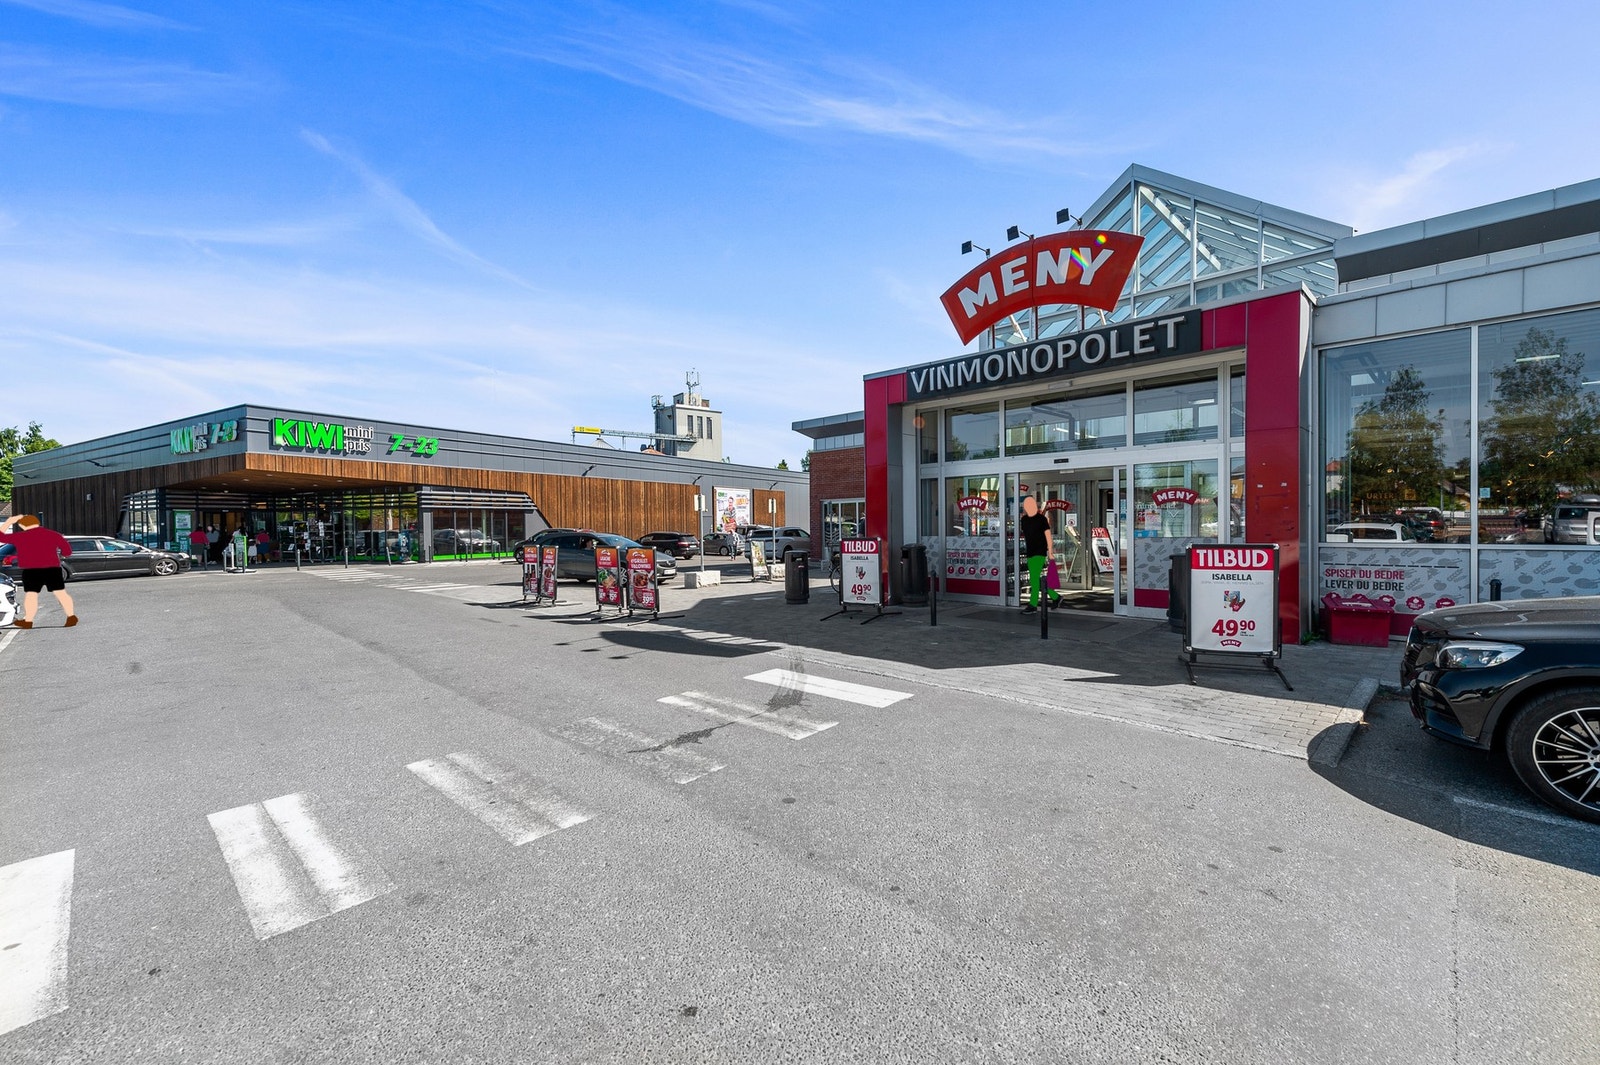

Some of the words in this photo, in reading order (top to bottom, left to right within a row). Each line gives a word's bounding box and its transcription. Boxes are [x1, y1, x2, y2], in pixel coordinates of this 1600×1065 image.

[957, 247, 1114, 319] MENY
[909, 315, 1185, 394] VINMONOPOLET
[274, 417, 345, 451] KIWI
[345, 426, 374, 440] mini
[345, 438, 372, 453] pris
[1156, 490, 1194, 502] MENY
[960, 498, 985, 509] MENY
[843, 540, 877, 553] TILBUD
[1196, 549, 1269, 568] TILBUD
[1212, 573, 1252, 581] ISABELLA
[1325, 568, 1357, 579] SPISER
[1359, 569, 1372, 580] DU
[1374, 570, 1405, 581] BEDRE
[1325, 579, 1354, 590] LEVER
[1356, 580, 1369, 591] DU
[1372, 581, 1405, 592] BEDRE
